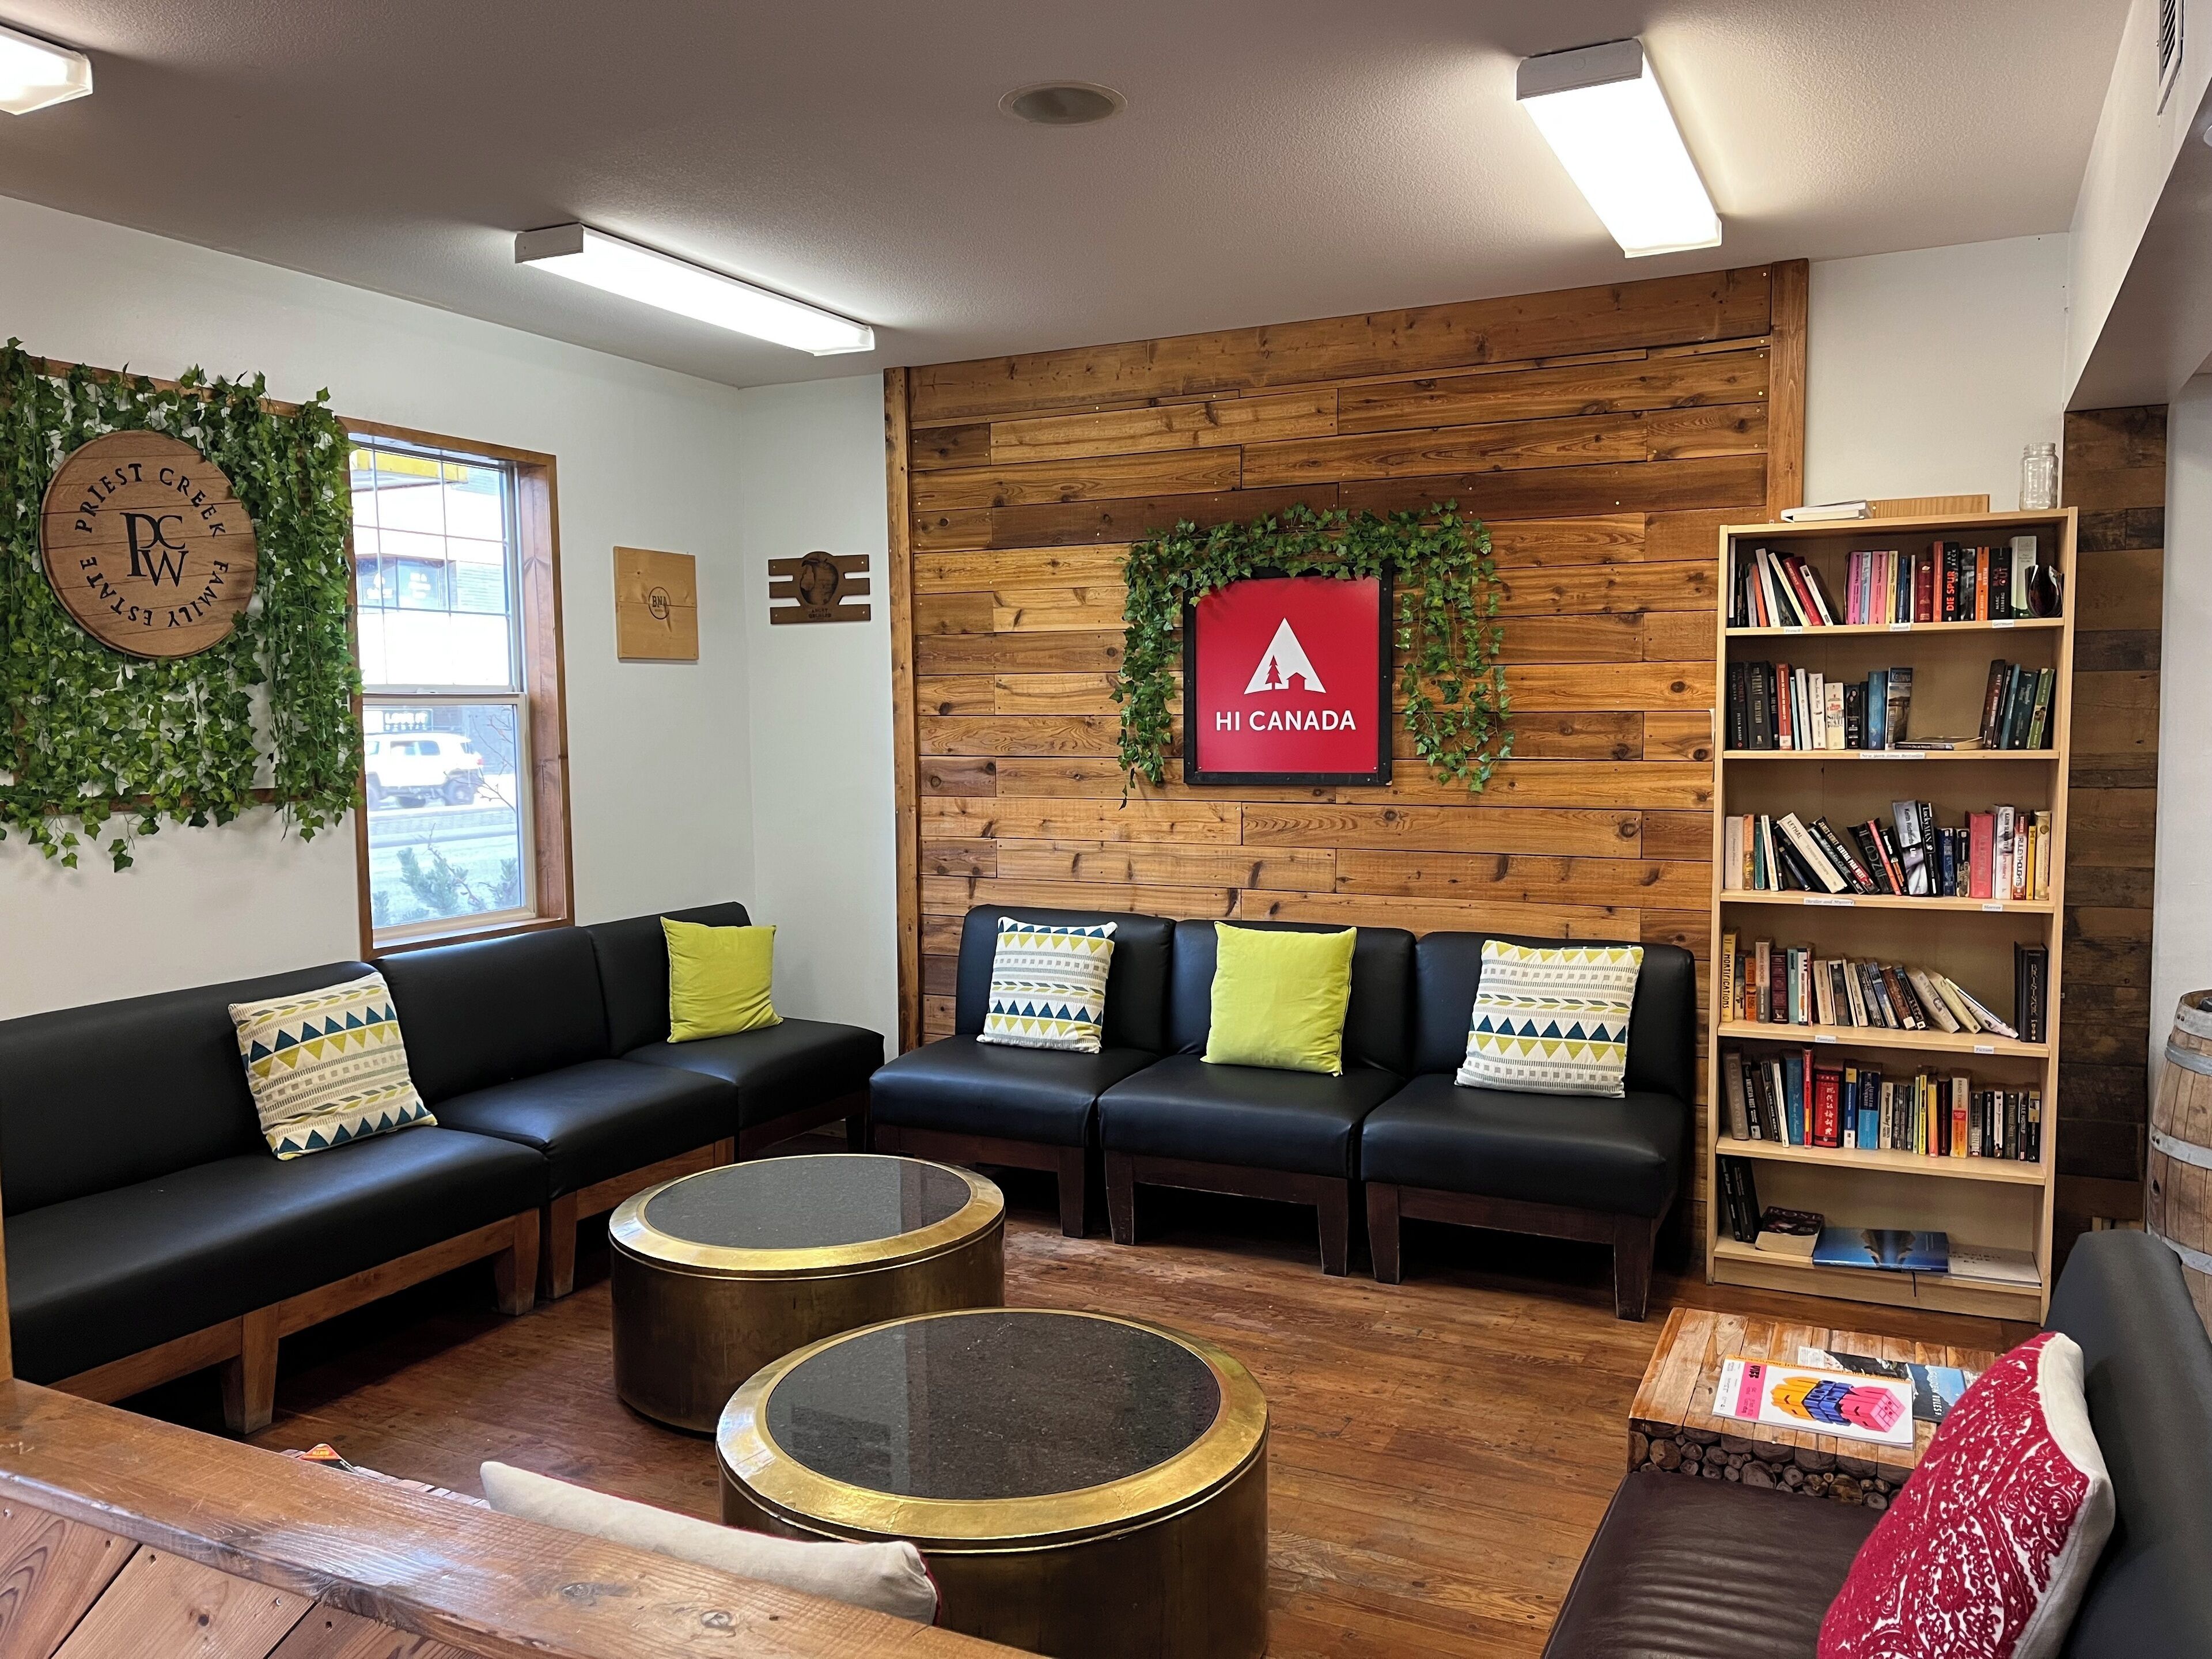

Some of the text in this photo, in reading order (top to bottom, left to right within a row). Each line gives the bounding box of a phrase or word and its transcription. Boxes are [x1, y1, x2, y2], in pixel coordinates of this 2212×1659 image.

[75, 463, 226, 538] PRIEST CREEK
[79, 556, 229, 627] FAMILY ESTATE
[652, 596, 668, 608] BNA
[1946, 571, 1955, 611] DIE SPUR
[1216, 710, 1357, 731] HI CANADA
[1787, 820, 1803, 839] LETHAL
[1905, 822, 1915, 844] Richards
[1836, 844, 1851, 862] CENTRAL
[1847, 857, 1859, 871] PARK
[2016, 855, 2024, 887] THOUGHTS
[1722, 954, 1731, 1009] MORTIFICATIONS
[2030, 964, 2038, 1016] BRISINGR
[1745, 1078, 1754, 1098] AMERICAN
[1734, 1096, 1742, 1129] SWORD
[1931, 1395, 1943, 1412] RULES
